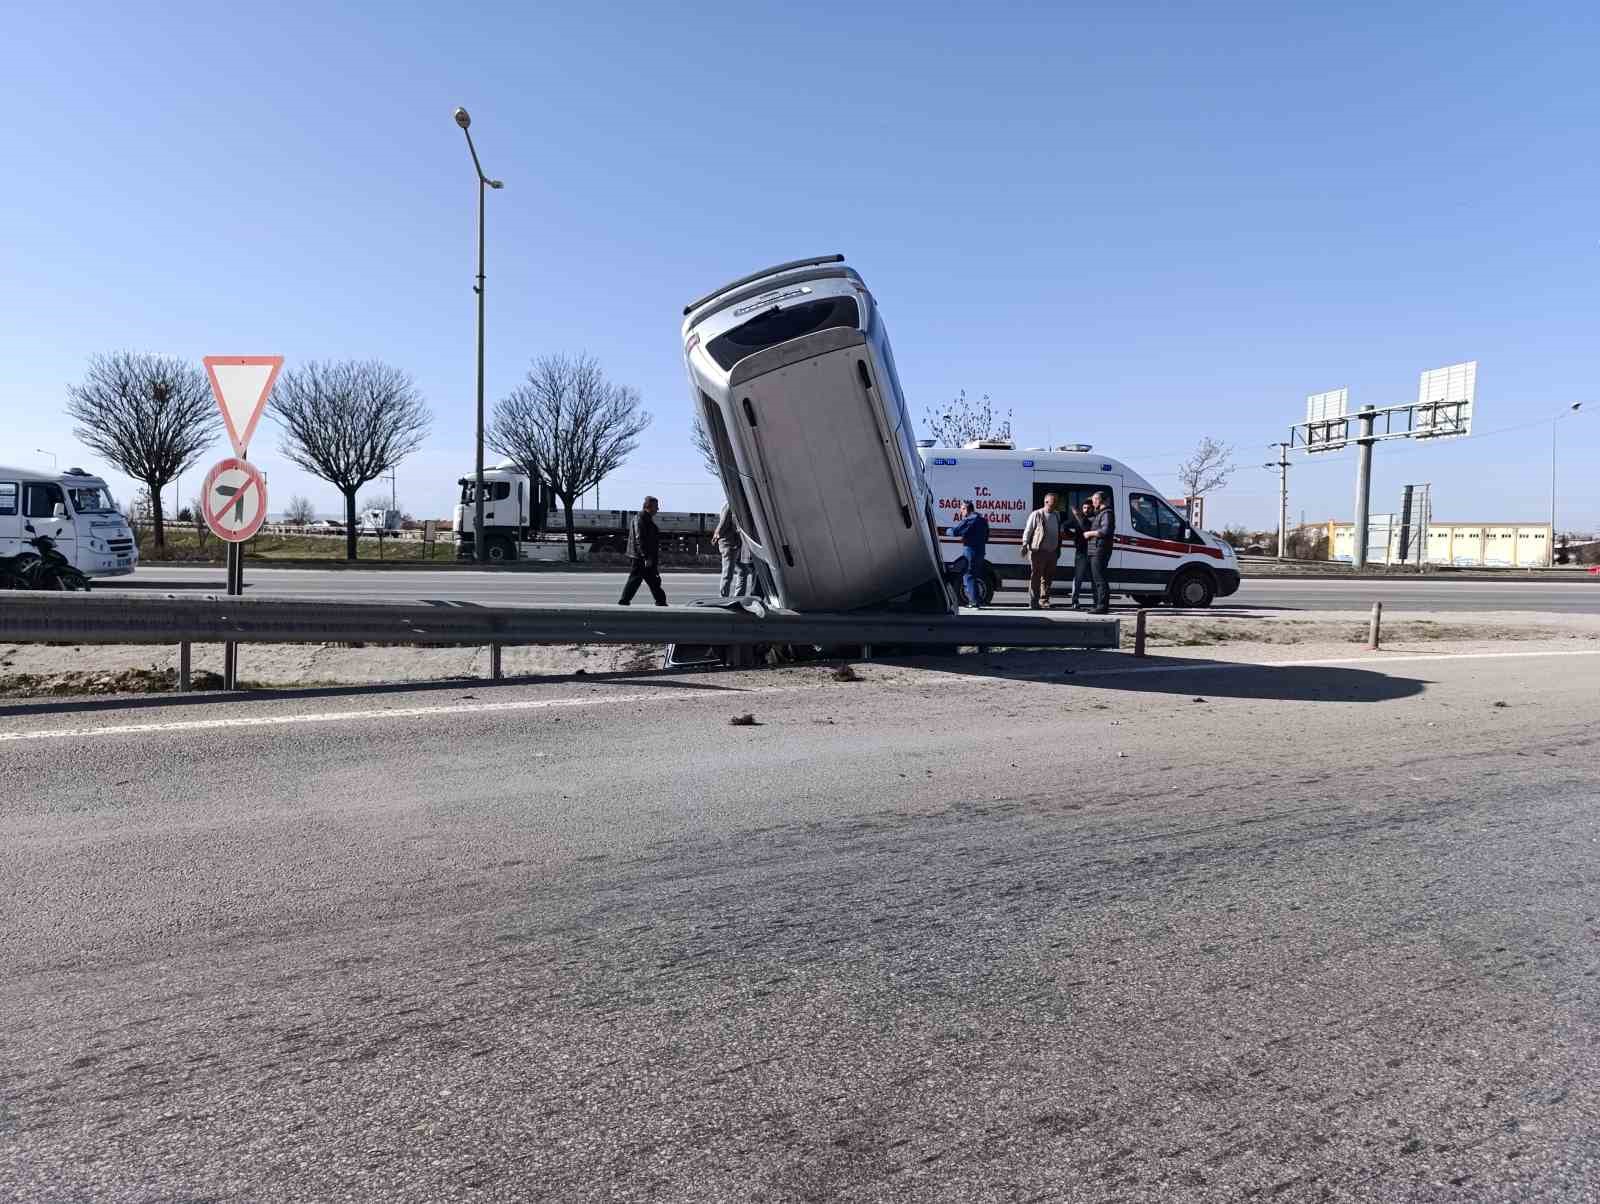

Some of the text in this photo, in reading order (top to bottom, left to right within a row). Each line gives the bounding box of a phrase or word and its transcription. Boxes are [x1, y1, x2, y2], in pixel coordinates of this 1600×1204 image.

[974, 486, 991, 496] T.C.
[939, 497, 1026, 510] SAĞL BAKANLIĞI
[983, 512, 1010, 523] AĞLIK
